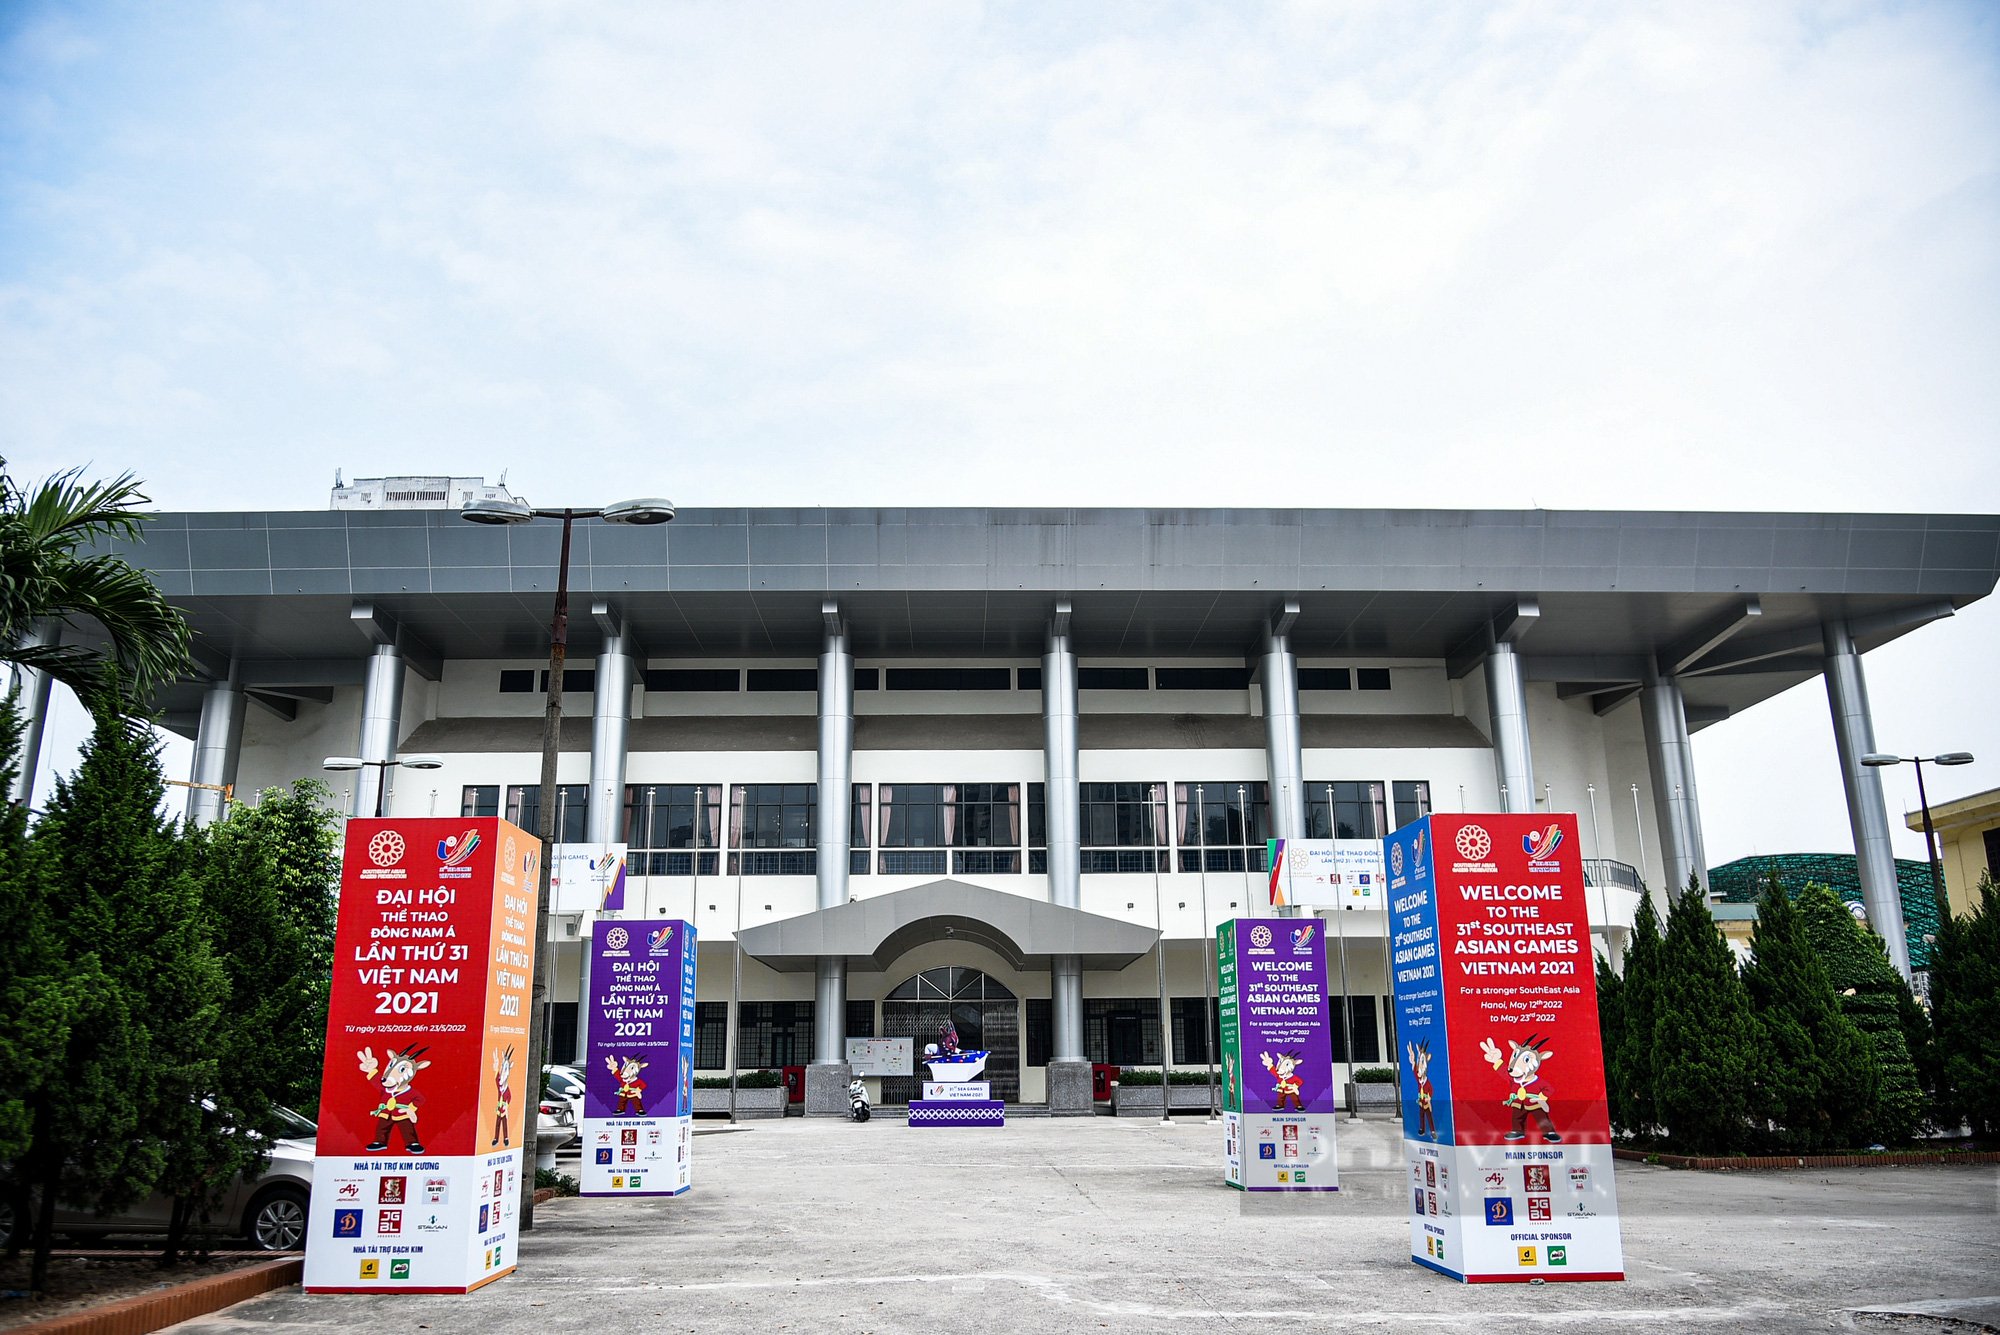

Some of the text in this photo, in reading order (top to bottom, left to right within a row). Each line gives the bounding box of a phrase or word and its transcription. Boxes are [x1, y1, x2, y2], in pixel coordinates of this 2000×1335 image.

[376, 885, 455, 908] ĐẠI HỘI
[1460, 885, 1562, 900] WELCOME
[1394, 890, 1428, 914] WELCOME
[381, 909, 448, 922] THỂ THAO
[1486, 906, 1539, 918] TO THE
[1403, 913, 1421, 928] TO THE
[1457, 920, 1573, 935] 31st SOUTHEAST
[371, 925, 456, 938] ĐÔNG NAM Á
[1403, 926, 1432, 945] SOUTHEAST
[355, 941, 468, 960] LẦN THỨ 31
[1395, 942, 1435, 964] ASIAN GAMES
[1455, 940, 1578, 954] ASIAN GAMES
[612, 960, 660, 974] ĐẠI HỘI
[1252, 962, 1312, 971] WELCOME
[1398, 964, 1435, 983] VIETNAM 2021
[1461, 961, 1574, 975] VIETNAM 2021
[358, 965, 458, 988] VIỆT NAM
[496, 968, 525, 990] VIỆT NAM
[616, 973, 632, 982] THỂ
[610, 983, 633, 992] ĐÔNG
[654, 983, 660, 991] Á
[1249, 982, 1263, 992] 31st
[1482, 987, 1518, 996] stronger
[375, 992, 438, 1014] 2021
[500, 994, 519, 1016] 2021
[601, 993, 668, 1005] LẦN THỨ 31
[1247, 994, 1320, 1002] ASIAN GAMES
[1481, 1001, 1507, 1010] Hanoi,
[1509, 1001, 1528, 1010] May
[1529, 999, 1543, 1009] 12th
[604, 1007, 663, 1021] VIỆT NAM
[1251, 1007, 1317, 1015] VIETNAM 2021
[1500, 1015, 1519, 1024] May
[1520, 1013, 1535, 1022] 23rd
[378, 1024, 412, 1033] 12/5/2022
[413, 1024, 428, 1032] đến
[430, 1024, 466, 1032] 23/5/2022
[614, 1022, 652, 1036] 2021
[354, 1162, 369, 1170] NHÀ
[372, 1162, 382, 1170] TÀI
[384, 1162, 398, 1172] TRỢ
[399, 1162, 413, 1170] KIM
